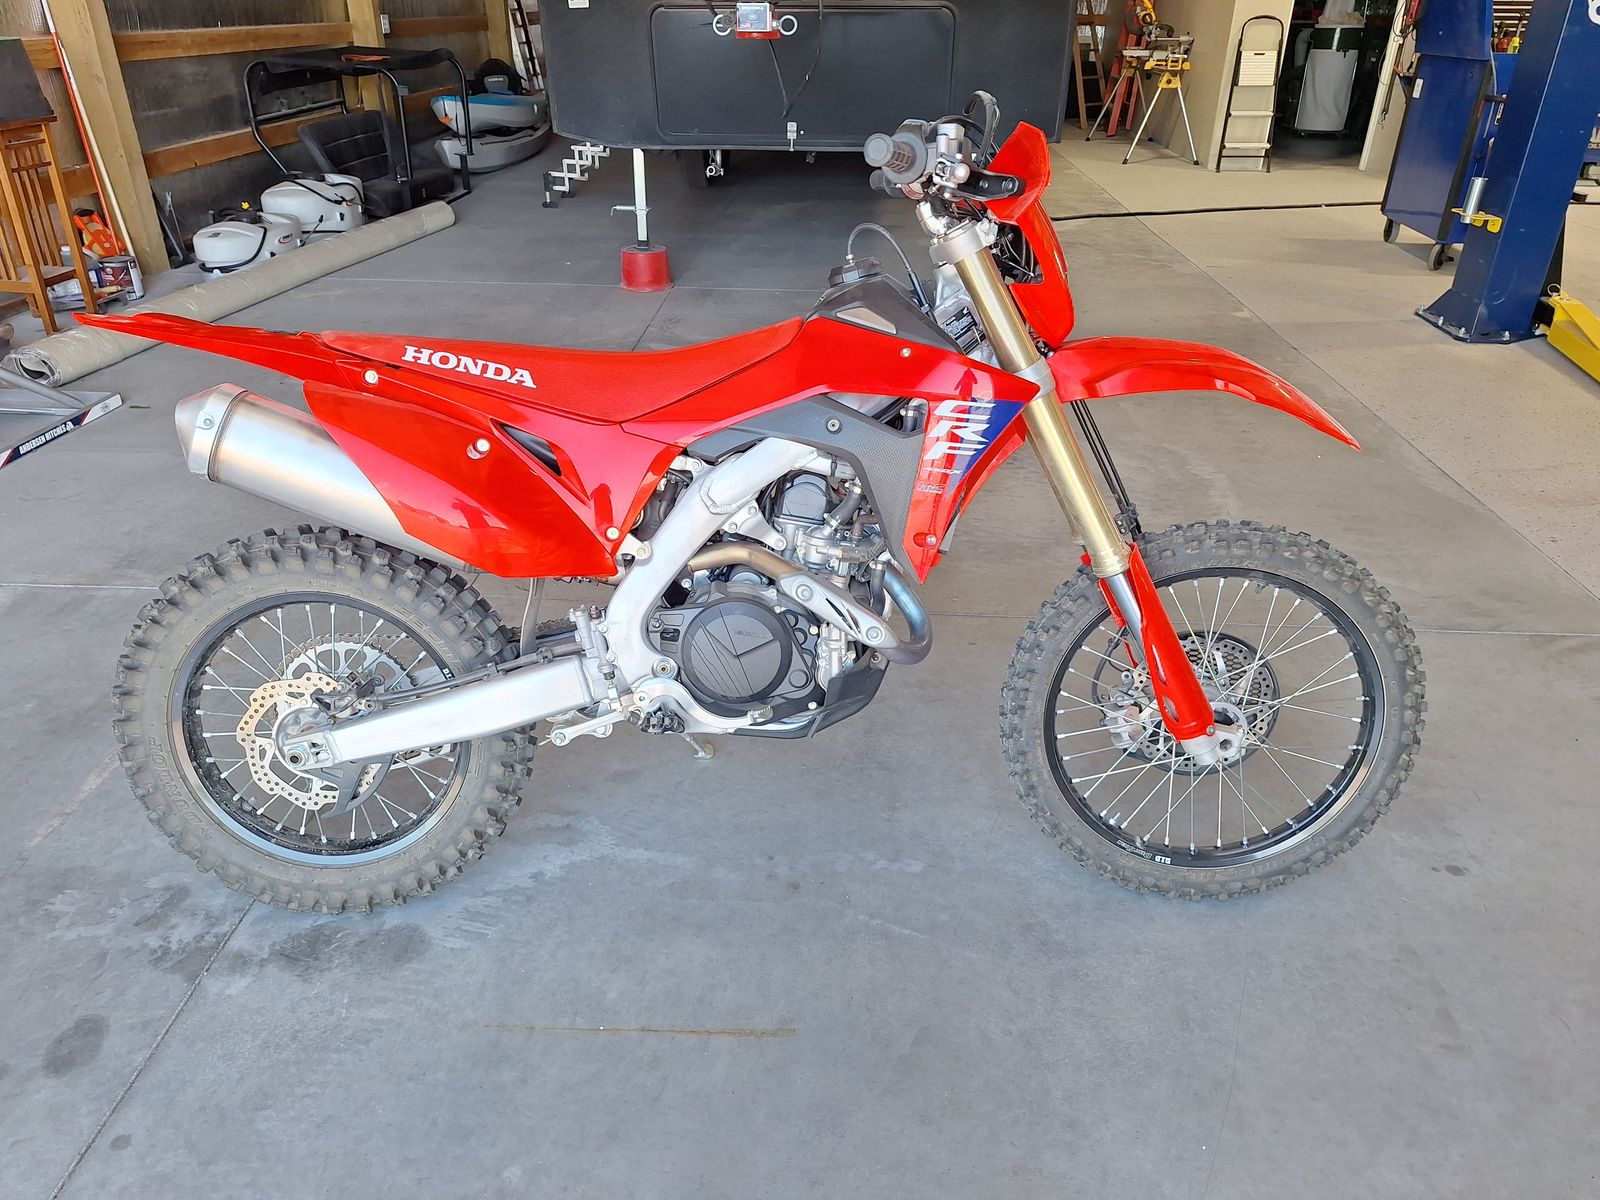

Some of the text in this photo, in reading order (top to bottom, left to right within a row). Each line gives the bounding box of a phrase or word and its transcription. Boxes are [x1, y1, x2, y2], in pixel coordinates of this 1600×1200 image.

[401, 345, 537, 389] HONDA
[19, 424, 67, 455] ANDERSEN HITCHES
[923, 399, 997, 461] CRF
[147, 735, 204, 825] DUNLOP
